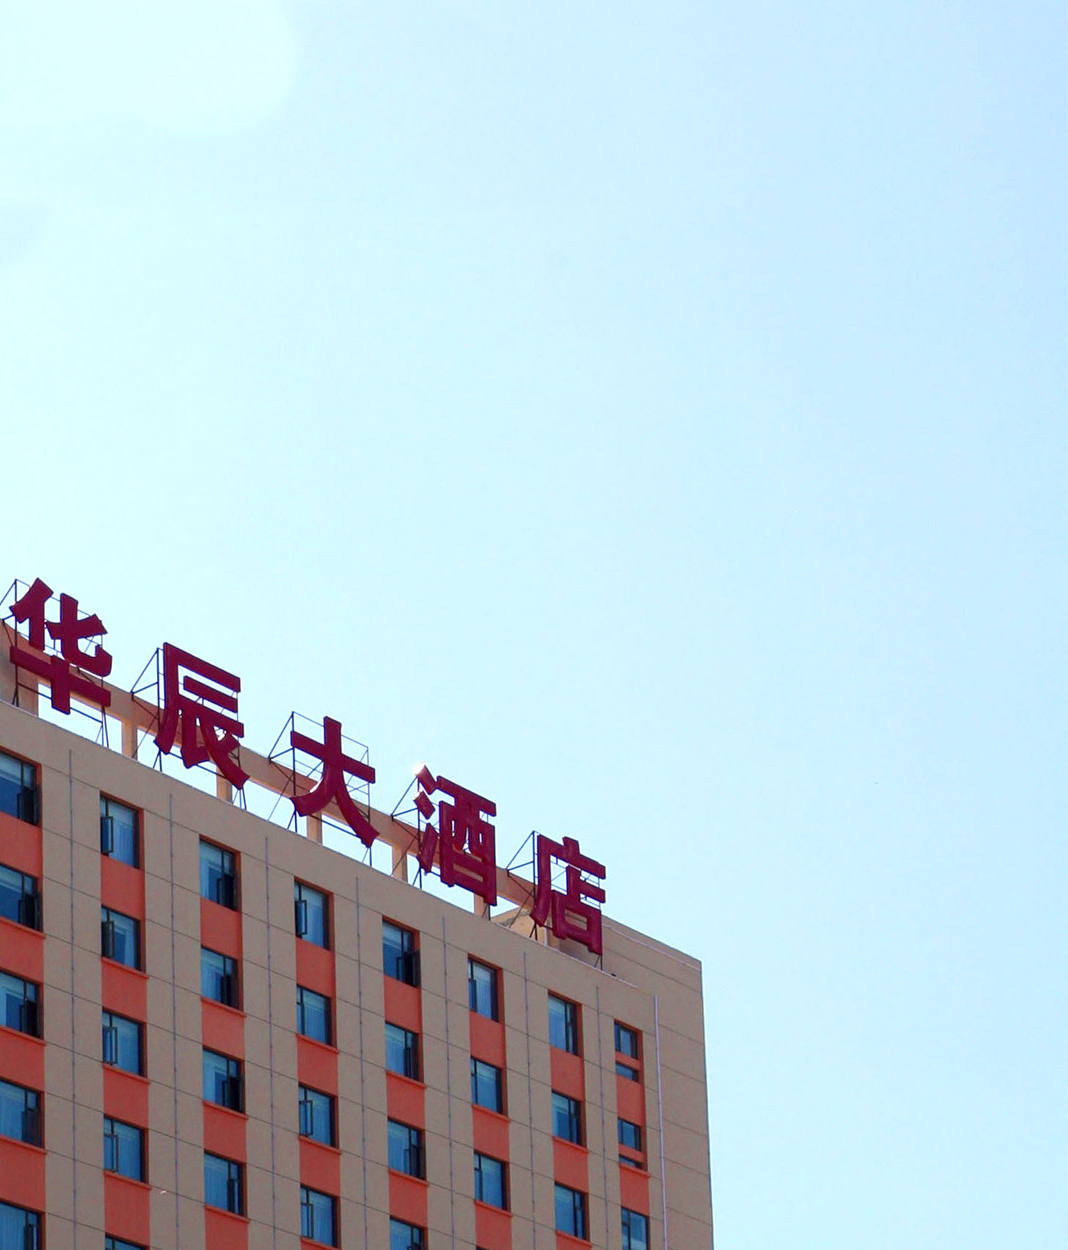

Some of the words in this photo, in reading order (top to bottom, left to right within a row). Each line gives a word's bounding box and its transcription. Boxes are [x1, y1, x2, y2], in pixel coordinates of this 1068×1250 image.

[9, 577, 607, 955] 华辰大酒店
